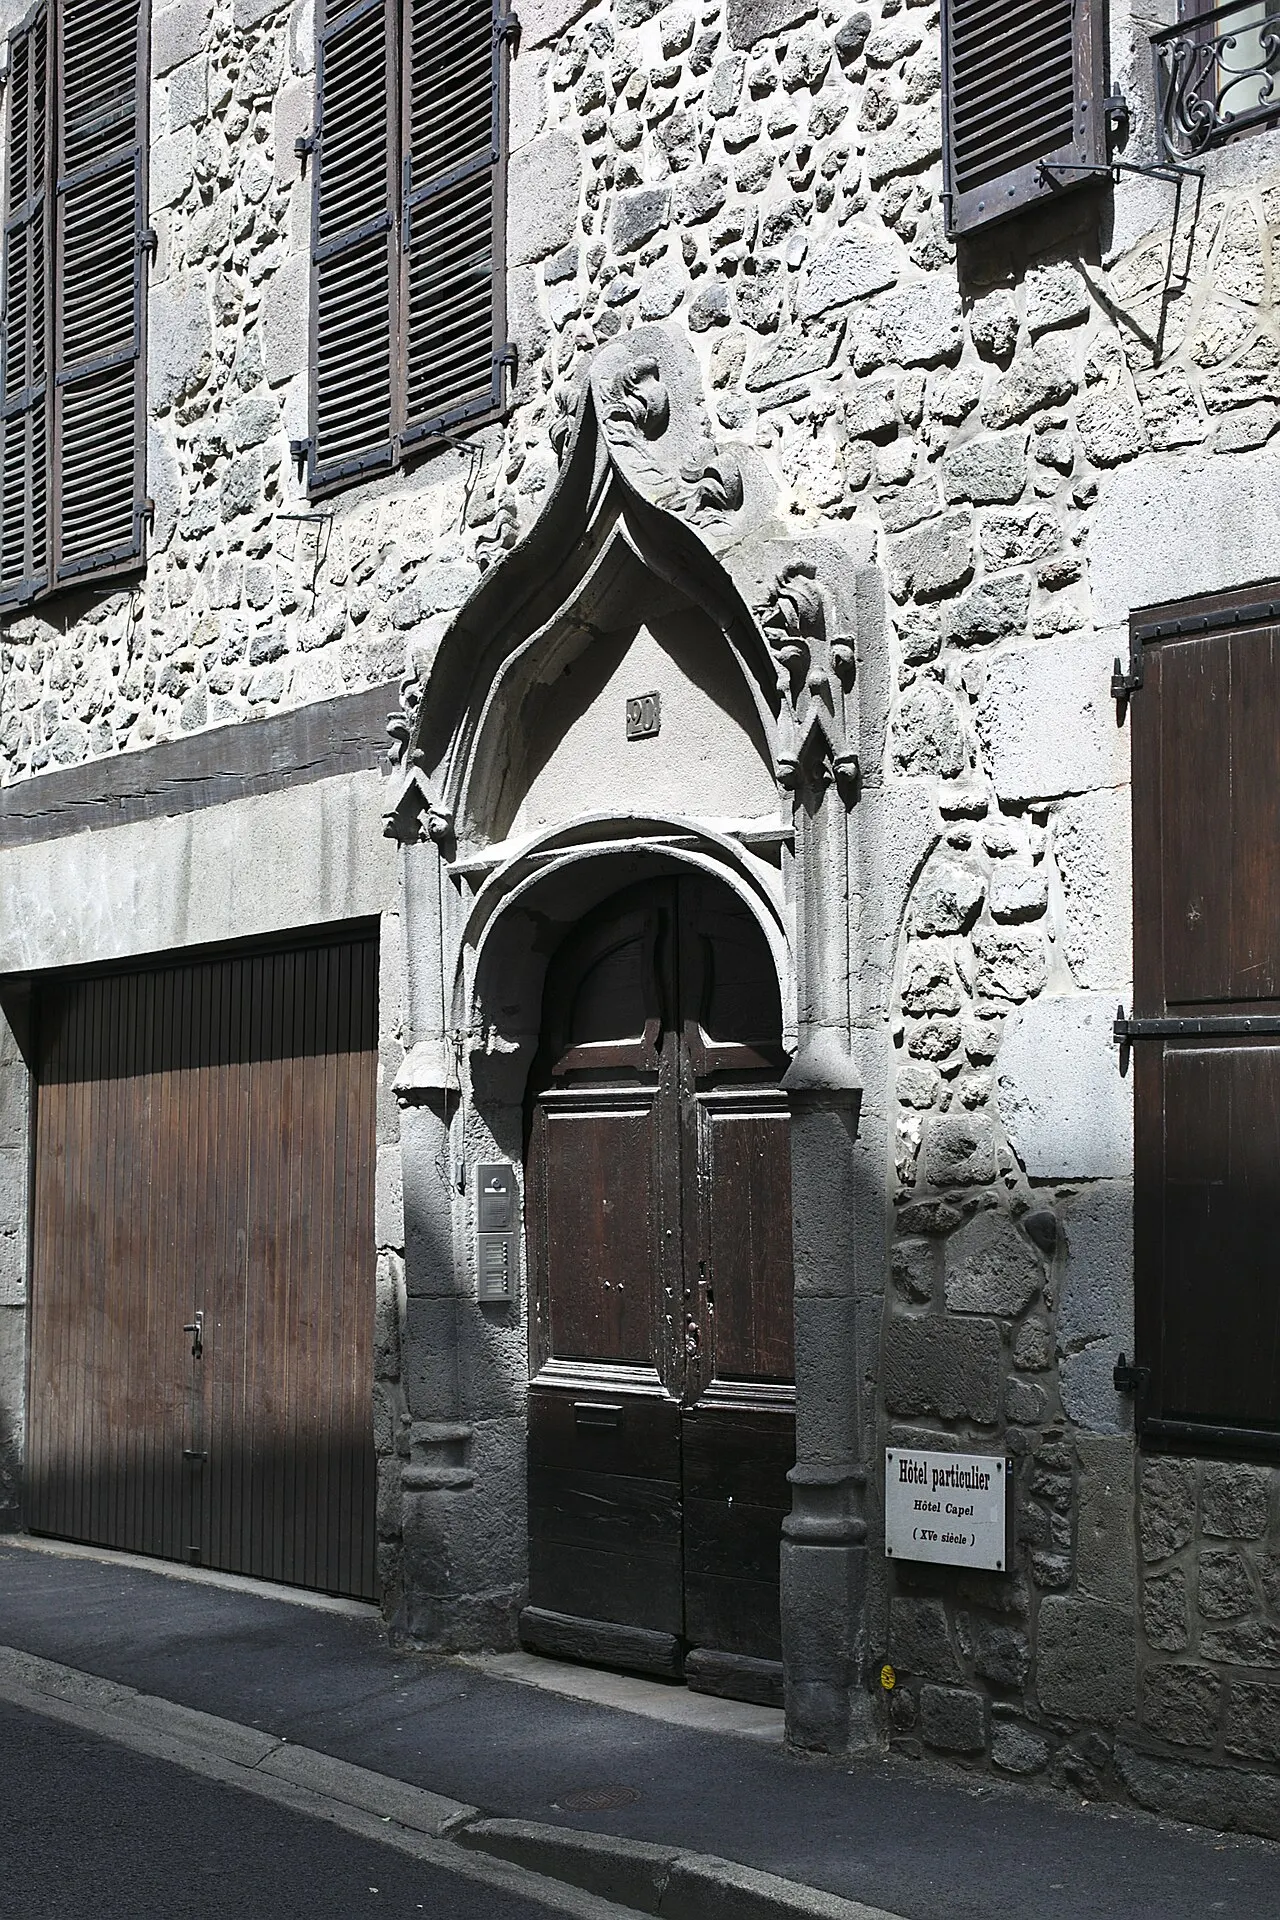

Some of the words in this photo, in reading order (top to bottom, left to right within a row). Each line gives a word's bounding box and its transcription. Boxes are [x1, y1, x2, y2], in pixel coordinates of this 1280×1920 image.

[631, 697, 654, 730] 20
[899, 1459, 928, 1485] Hôtel
[932, 1464, 990, 1492] particulier
[913, 1500, 941, 1513] Hôtel
[945, 1503, 974, 1517] Capel
[941, 1532, 967, 1544] siècle
